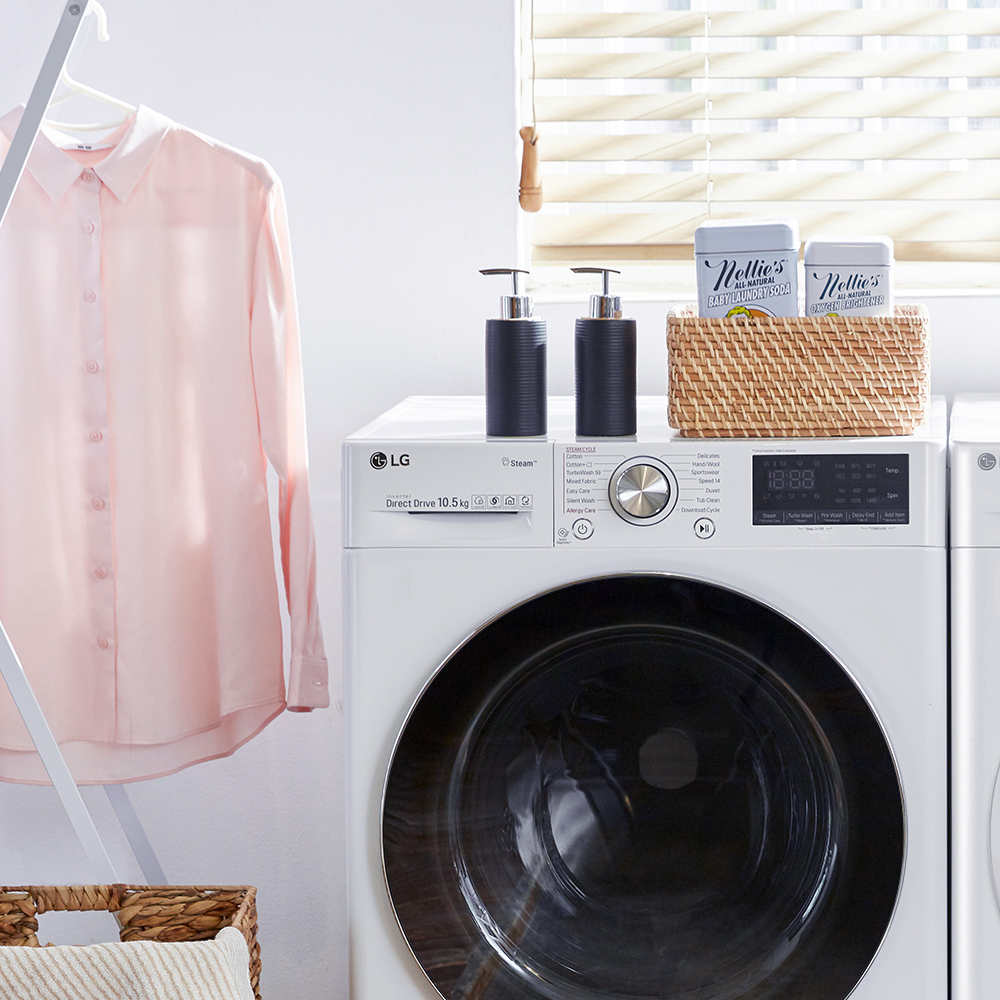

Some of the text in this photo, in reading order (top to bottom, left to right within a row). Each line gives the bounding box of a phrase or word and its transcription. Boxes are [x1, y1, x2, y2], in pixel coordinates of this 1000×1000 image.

[704, 259, 785, 291] Nellie's
[708, 282, 791, 308] BABY LAUNDRY SODA
[812, 272, 881, 300] Nellie's
[837, 290, 872, 300] ALL-NATURAL
[810, 296, 885, 314] OXYGEN BRIGHTENER
[391, 454, 410, 466] LG
[386, 497, 469, 509] Direct Drive 10.5 kg
